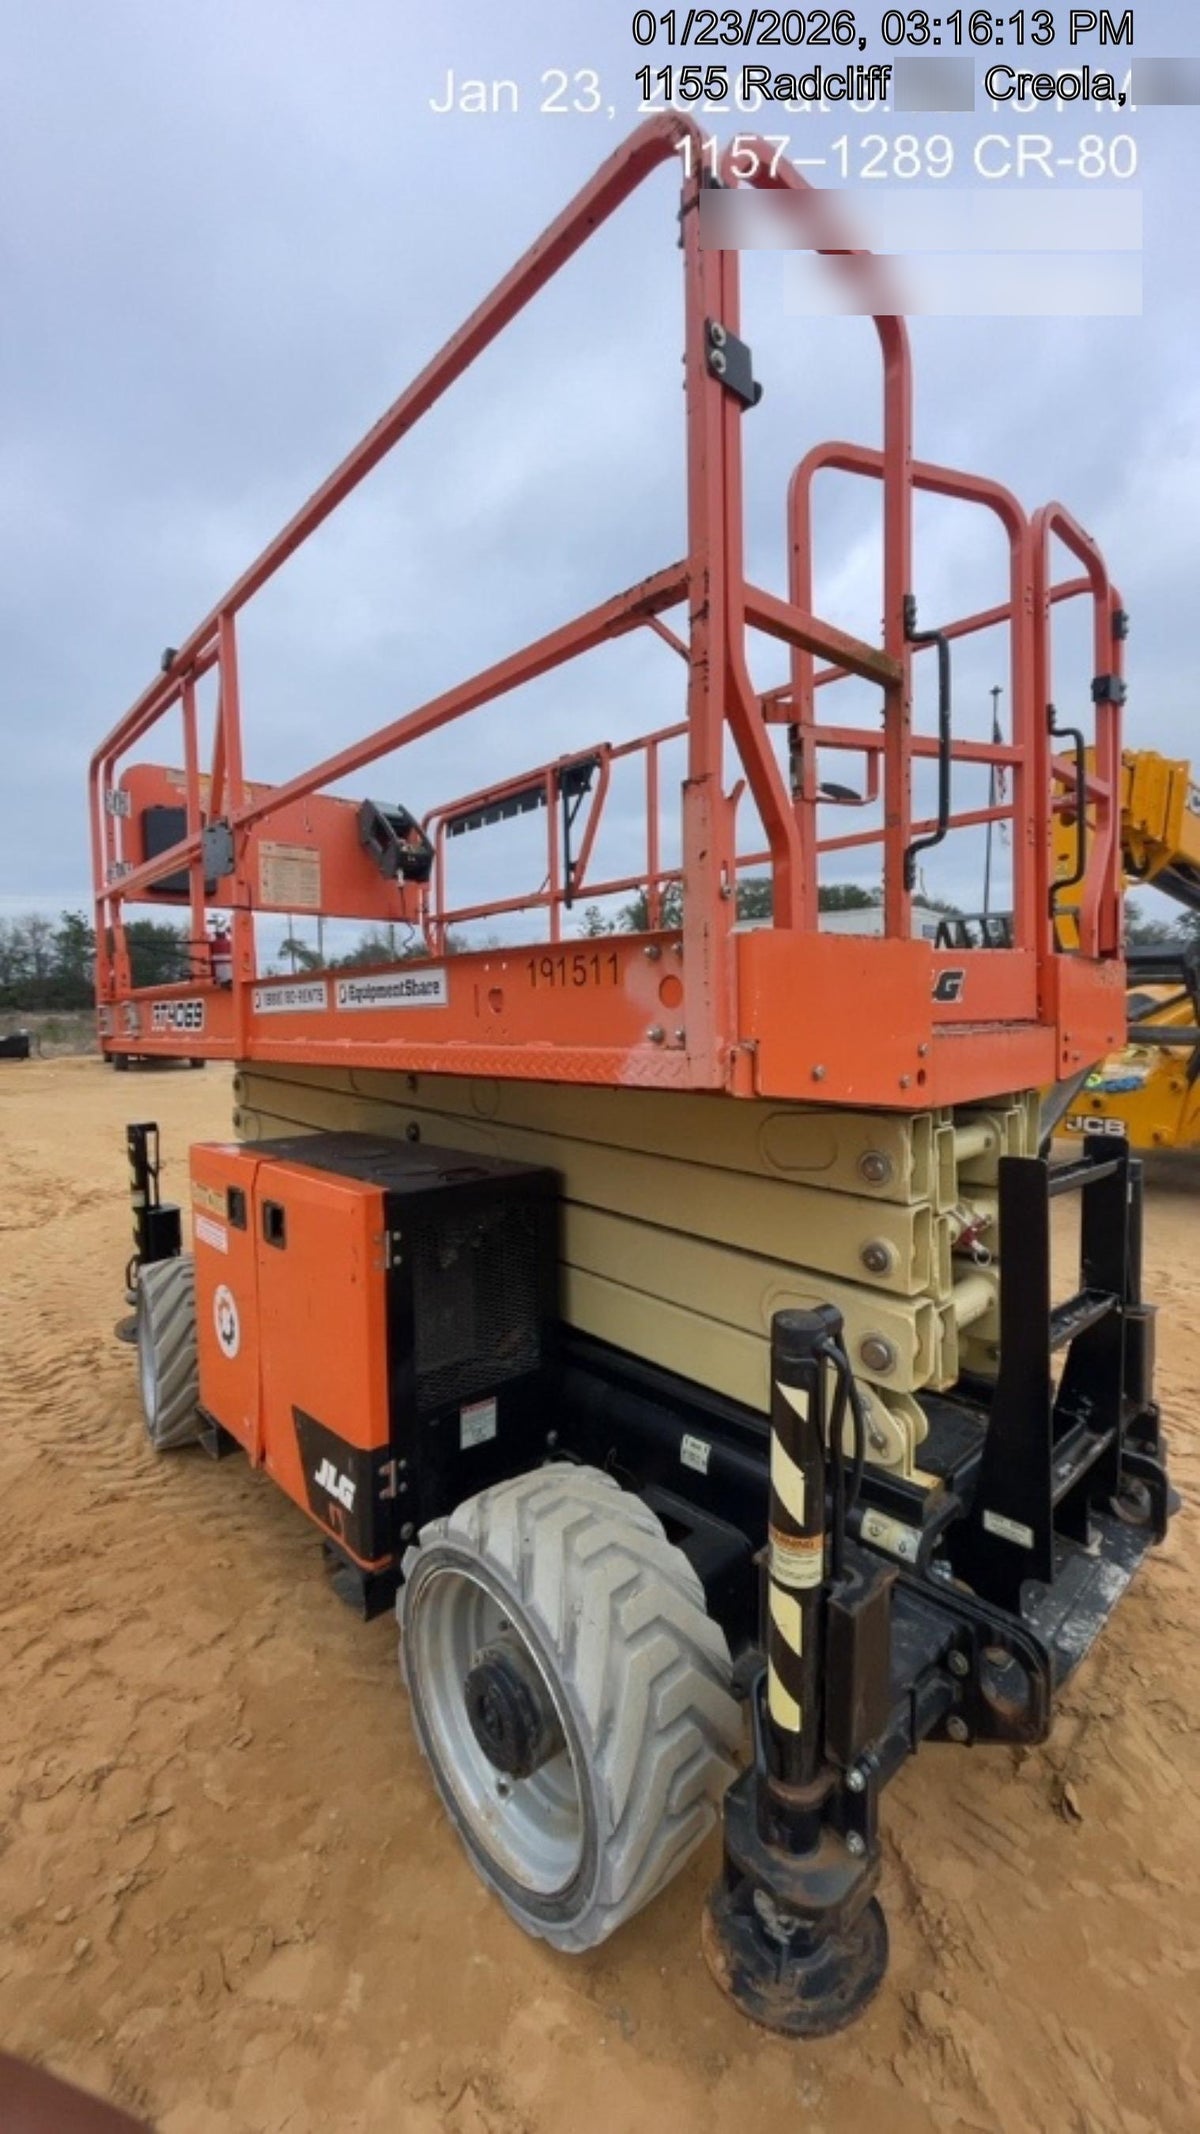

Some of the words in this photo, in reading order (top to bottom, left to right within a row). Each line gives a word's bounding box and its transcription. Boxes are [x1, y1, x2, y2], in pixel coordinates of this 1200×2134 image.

[527, 952, 618, 987] 191511
[1066, 1115, 1125, 1137] JCB
[314, 1457, 356, 1514] JLG
